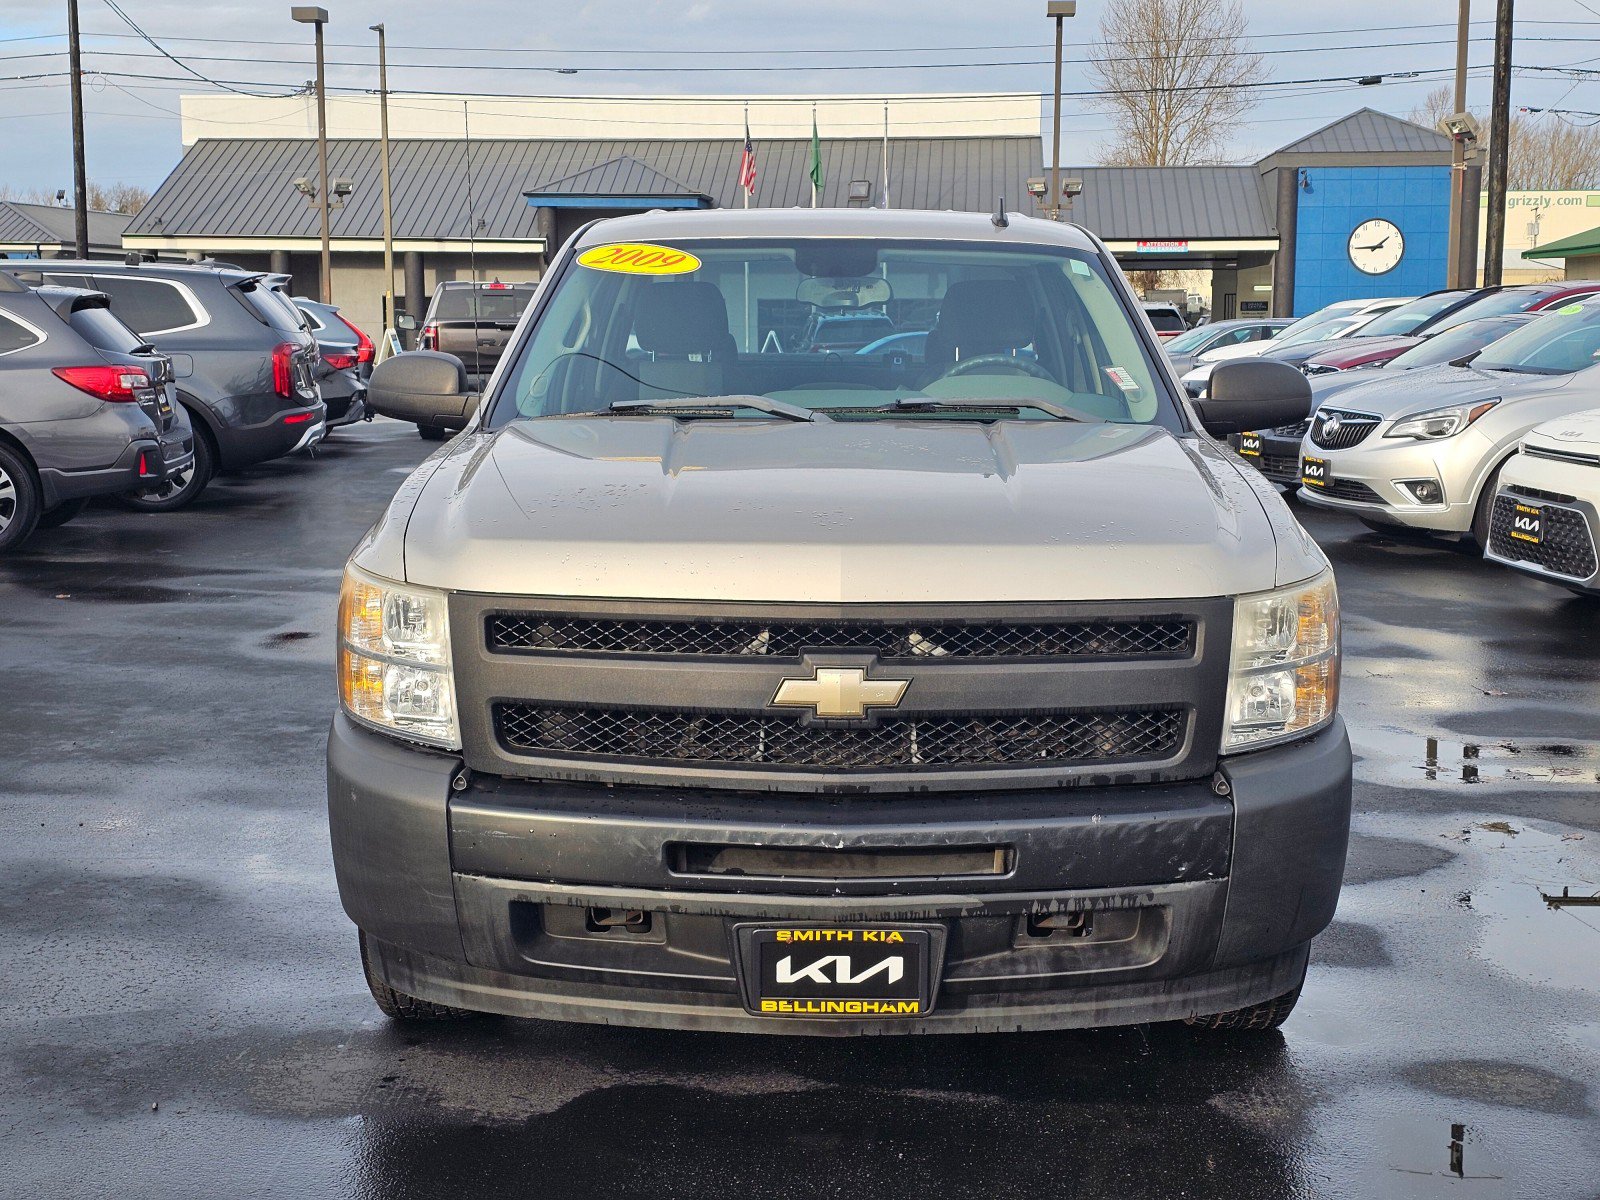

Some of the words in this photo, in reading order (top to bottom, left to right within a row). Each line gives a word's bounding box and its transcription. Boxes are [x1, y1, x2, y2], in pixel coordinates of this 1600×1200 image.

[1508, 195, 1582, 209] grizzly.com
[588, 248, 687, 268] 2009
[1243, 438, 1260, 448] KIA
[1305, 464, 1323, 476] KIA
[1514, 515, 1540, 532] KIA
[776, 930, 853, 942] SMITH
[863, 930, 904, 942] KIA
[776, 955, 904, 984] KIA
[761, 1000, 919, 1014] BELLINGHAM
